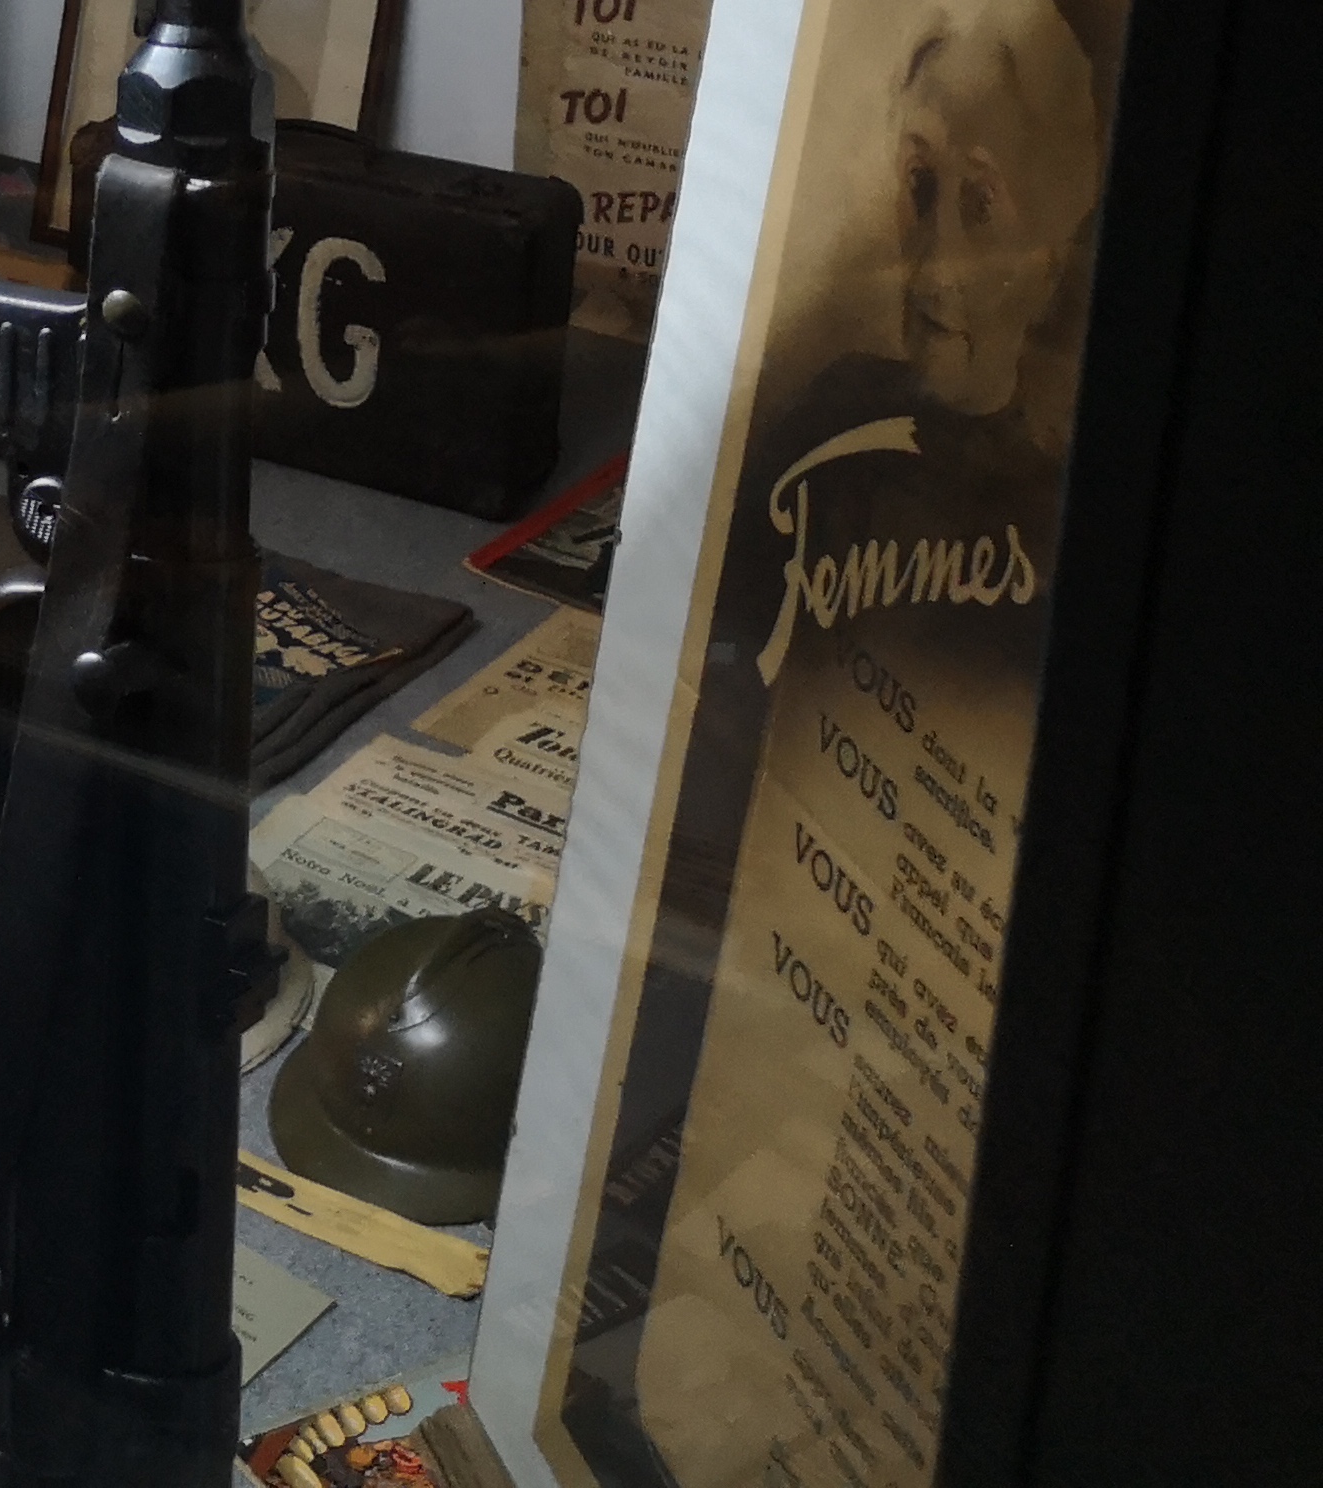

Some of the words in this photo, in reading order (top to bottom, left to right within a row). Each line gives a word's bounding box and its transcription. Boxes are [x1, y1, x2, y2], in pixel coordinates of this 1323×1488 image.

[560, 87, 629, 125] TOI
[757, 416, 1036, 687] Femmes
[342, 783, 503, 850] STALINGRAD
[818, 712, 899, 821] VOUS
[795, 822, 874, 937] VOUS
[770, 930, 849, 1049] VOUS
[717, 1215, 790, 1340] VOUS
